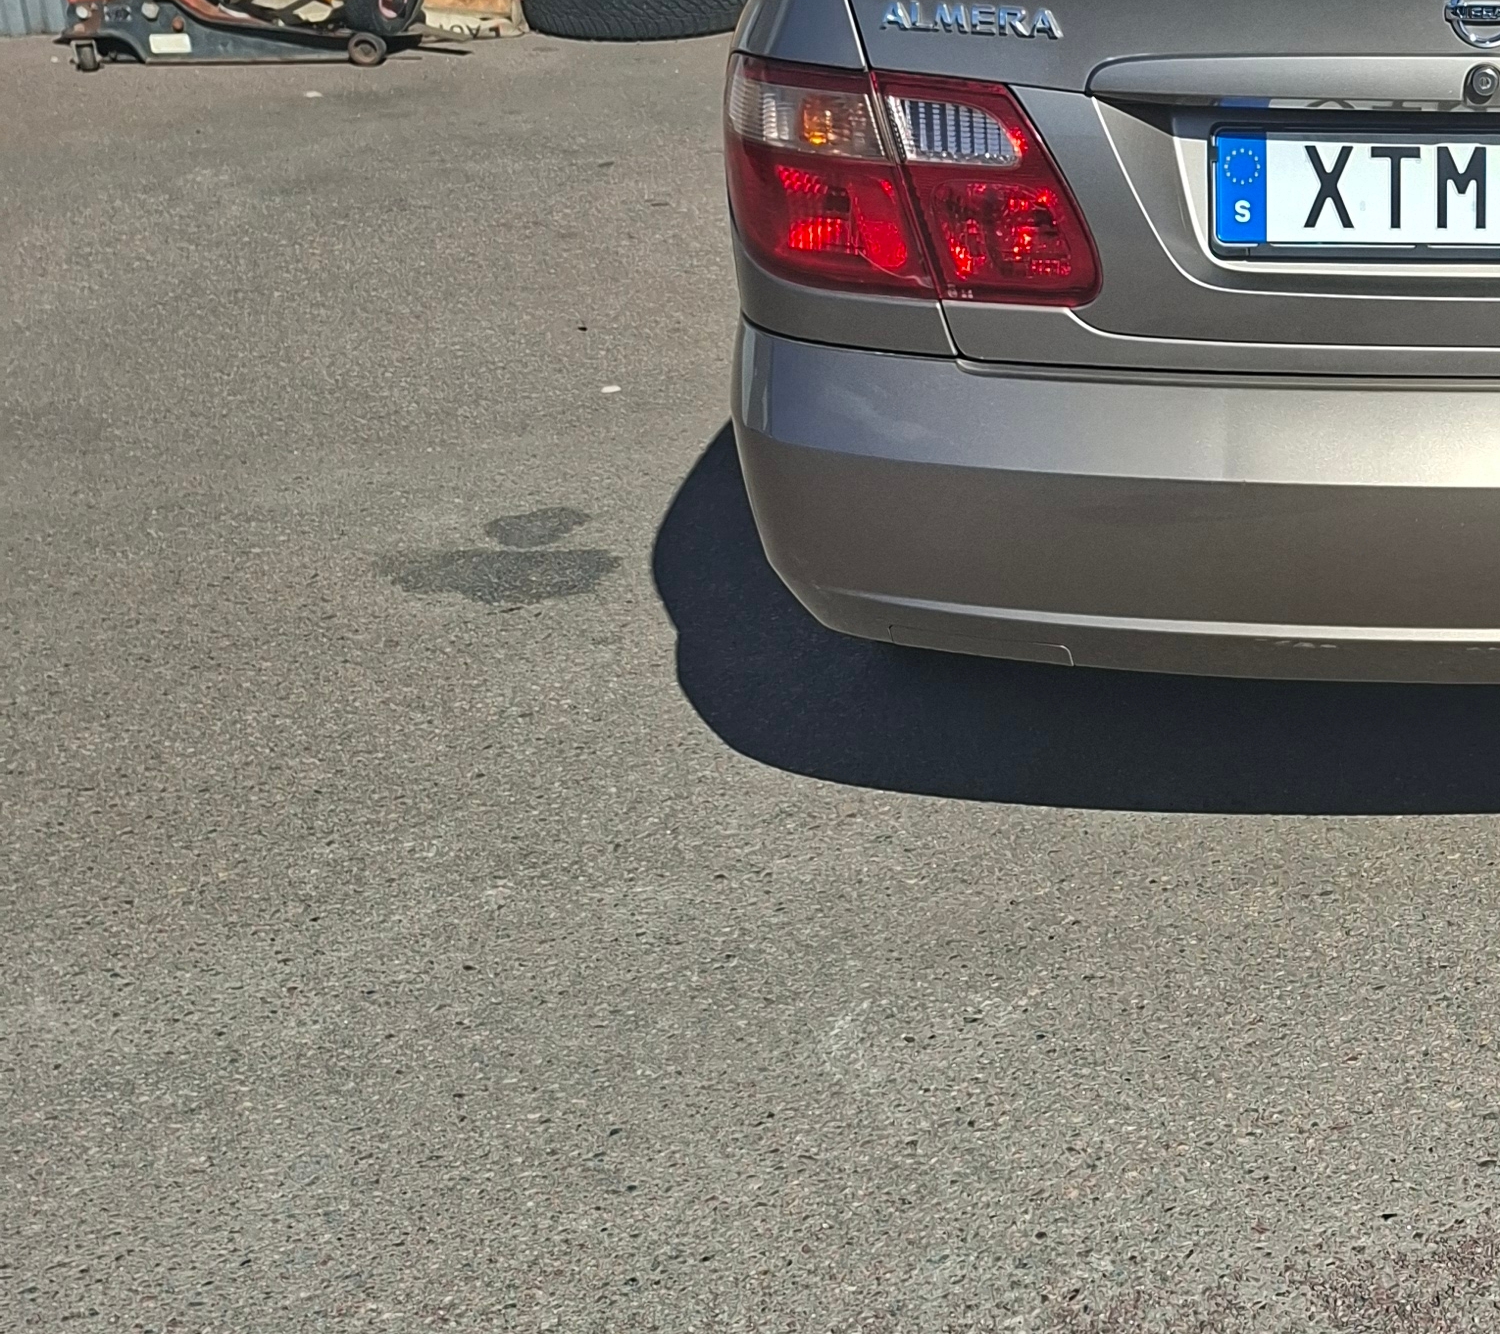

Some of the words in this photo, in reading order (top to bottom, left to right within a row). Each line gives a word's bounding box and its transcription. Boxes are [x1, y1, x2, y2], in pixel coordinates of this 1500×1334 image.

[880, 0, 1064, 39] ALMERA
[1303, 145, 1487, 230] XTM
[1234, 200, 1251, 223] S
